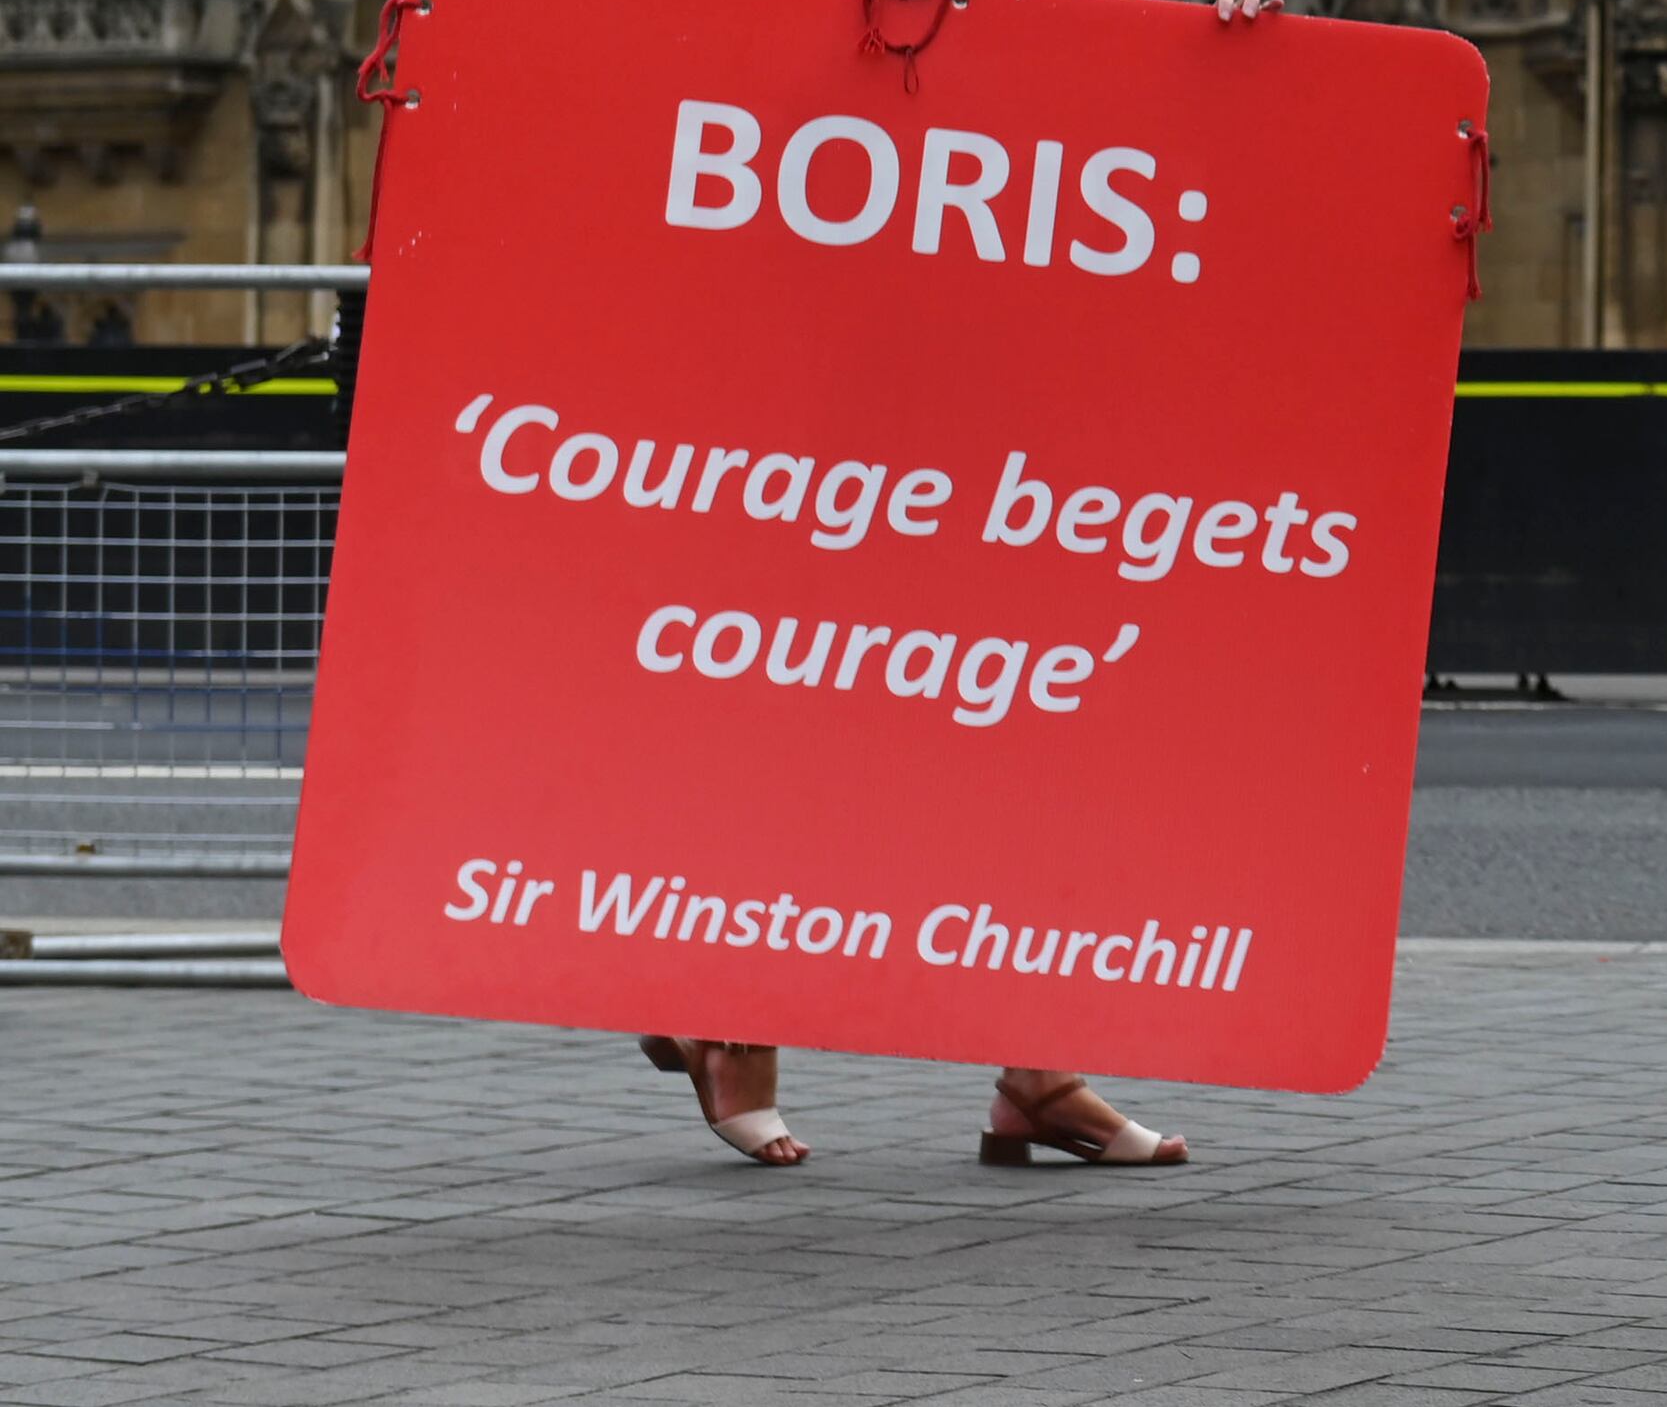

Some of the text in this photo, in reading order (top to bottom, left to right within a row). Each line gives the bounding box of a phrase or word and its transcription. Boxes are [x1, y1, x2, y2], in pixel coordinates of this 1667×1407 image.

[664, 99, 1209, 284] BORIS:
[454, 393, 1358, 582] ‘Courage begets
[636, 604, 1141, 727] courage’
[444, 858, 1254, 993] Sir Winston Churchill
